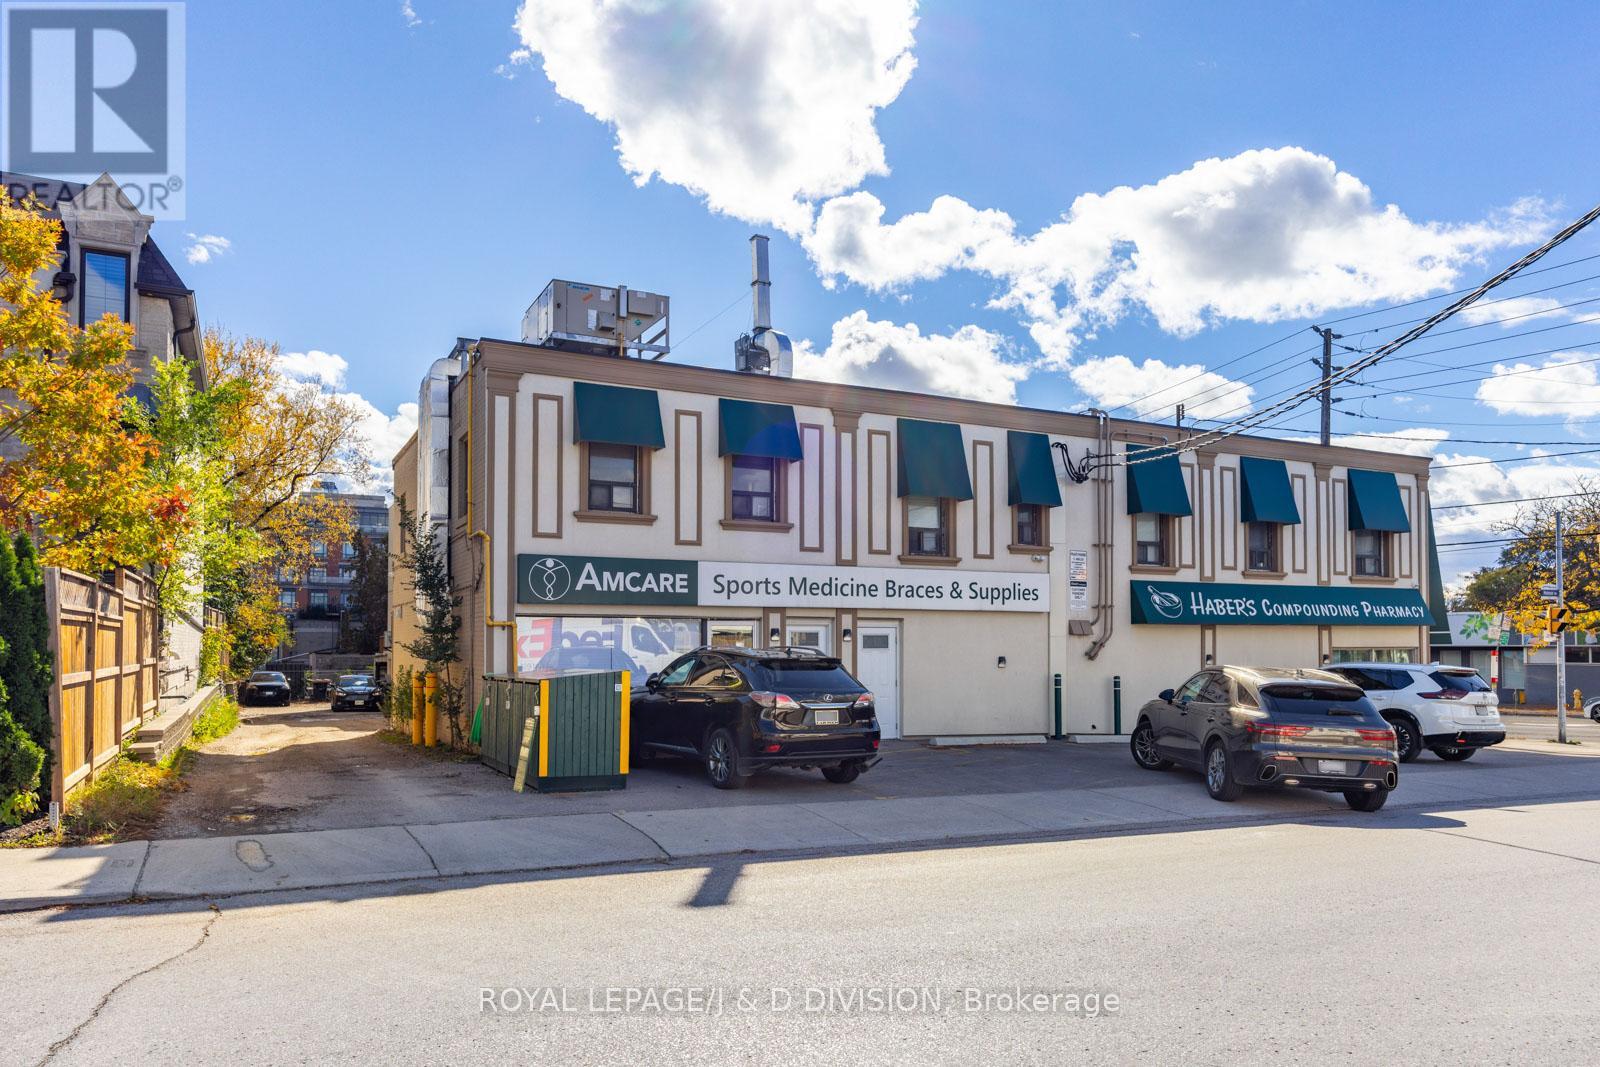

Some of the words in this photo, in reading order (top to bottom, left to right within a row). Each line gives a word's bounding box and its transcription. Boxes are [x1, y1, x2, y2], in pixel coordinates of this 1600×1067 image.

[713, 574, 781, 600] Sports
[789, 576, 879, 598] Medicine
[886, 580, 944, 599] Braces
[950, 582, 963, 599] &
[968, 582, 1040, 604] Supplies
[1190, 592, 1257, 616] HABER'S
[1262, 599, 1359, 617] COMPOUNDING
[1361, 601, 1425, 618] PHARMACY
